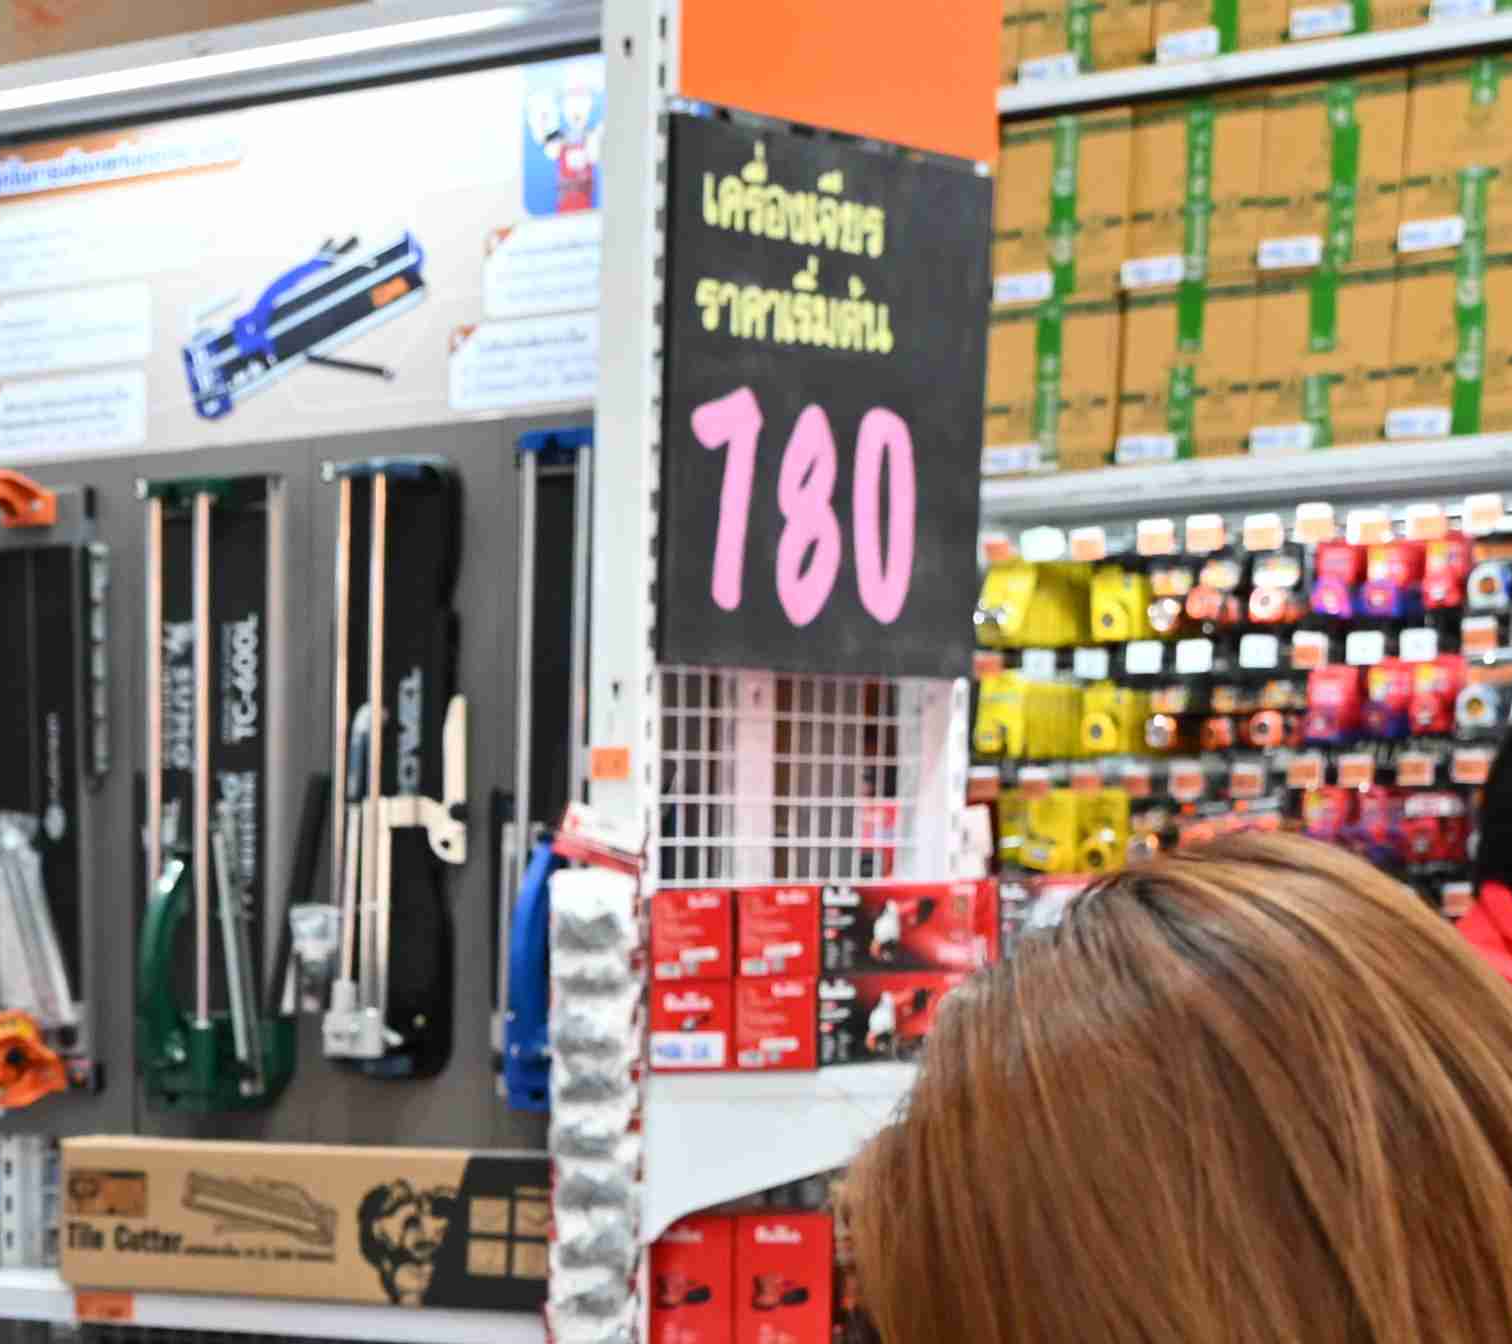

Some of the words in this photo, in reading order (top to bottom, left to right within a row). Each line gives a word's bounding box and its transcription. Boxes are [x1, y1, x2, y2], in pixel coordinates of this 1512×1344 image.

[695, 254, 895, 355] ราคาเริ่มต้น
[66, 1219, 104, 1251] Tile
[113, 1222, 182, 1254] Cutter
